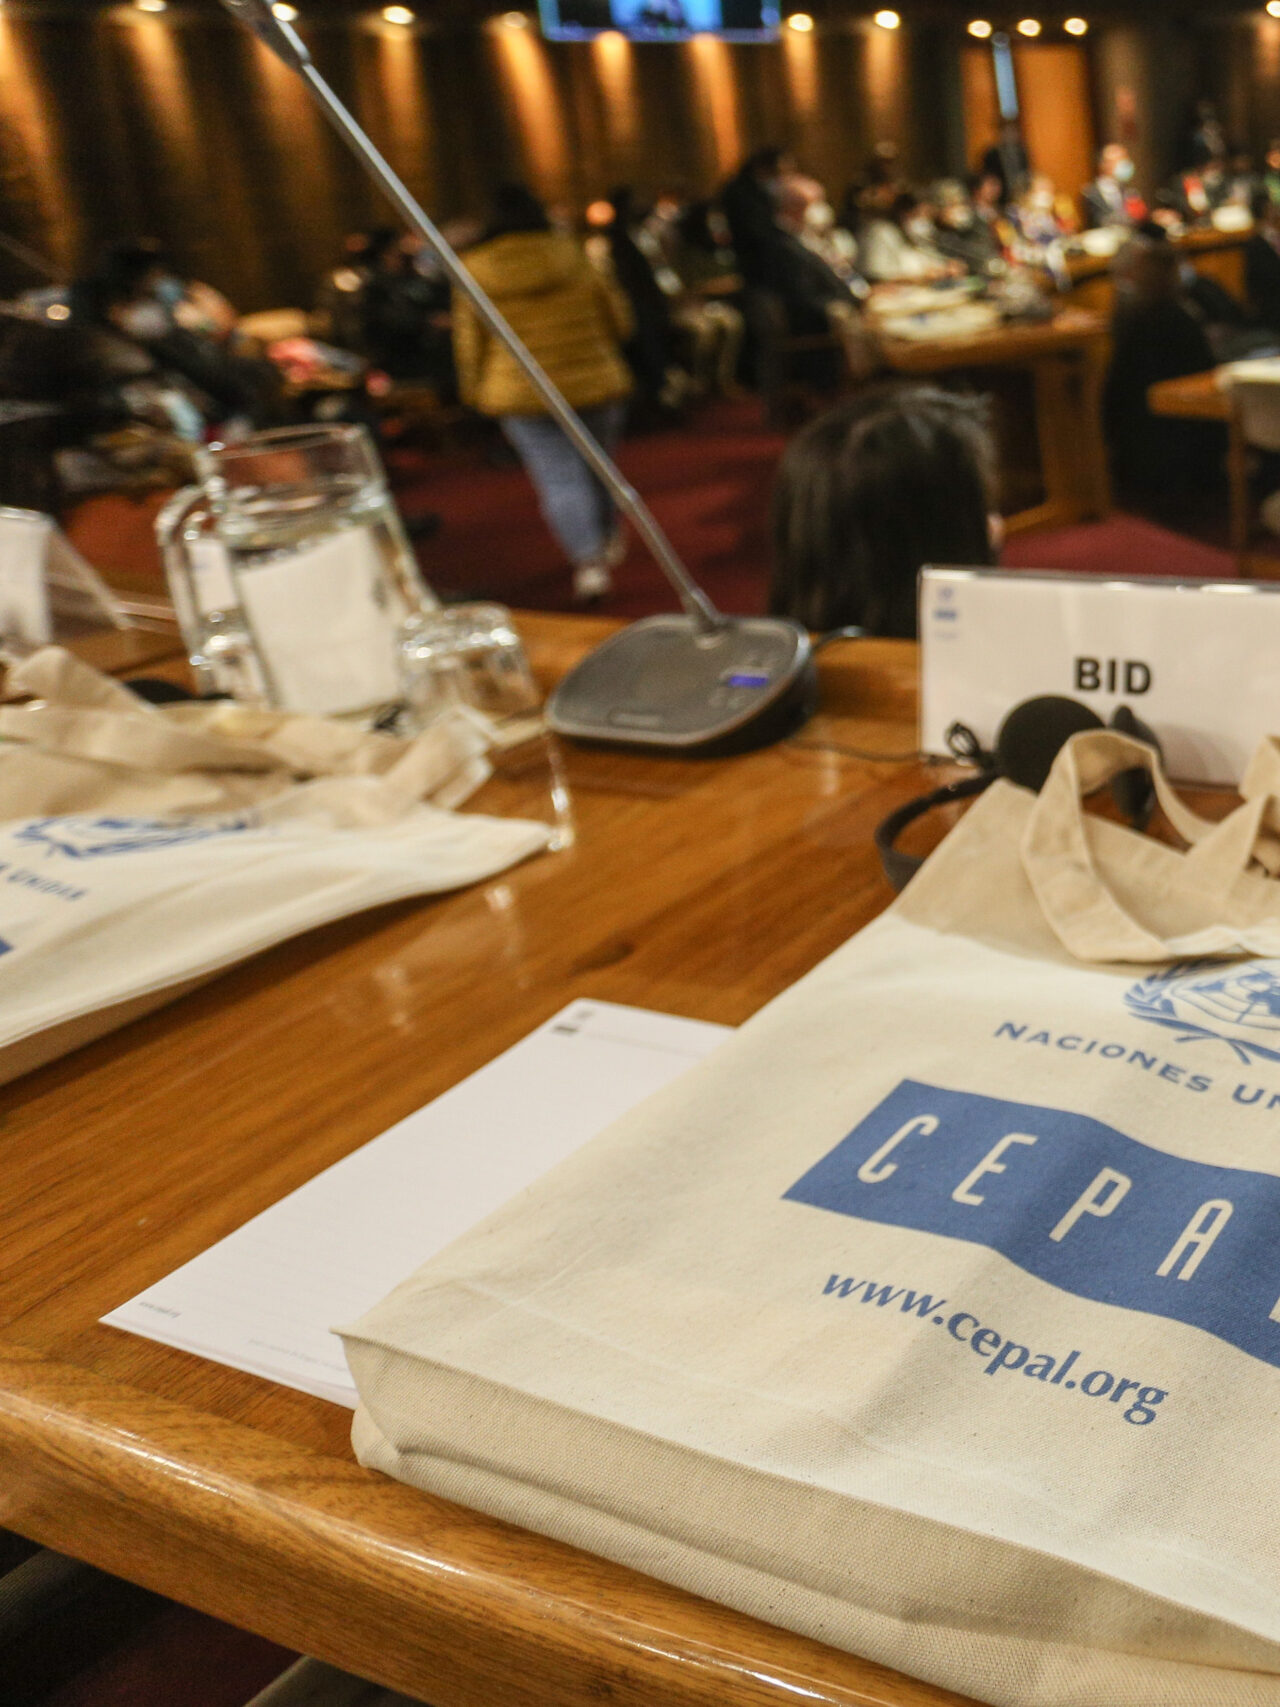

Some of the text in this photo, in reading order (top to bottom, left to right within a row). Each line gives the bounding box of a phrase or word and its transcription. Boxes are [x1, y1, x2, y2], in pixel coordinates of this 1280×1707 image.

[1075, 656, 1152, 694] BID
[994, 1022, 1213, 1092] NACIONES
[822, 1274, 1169, 1426] www.cepal.org
